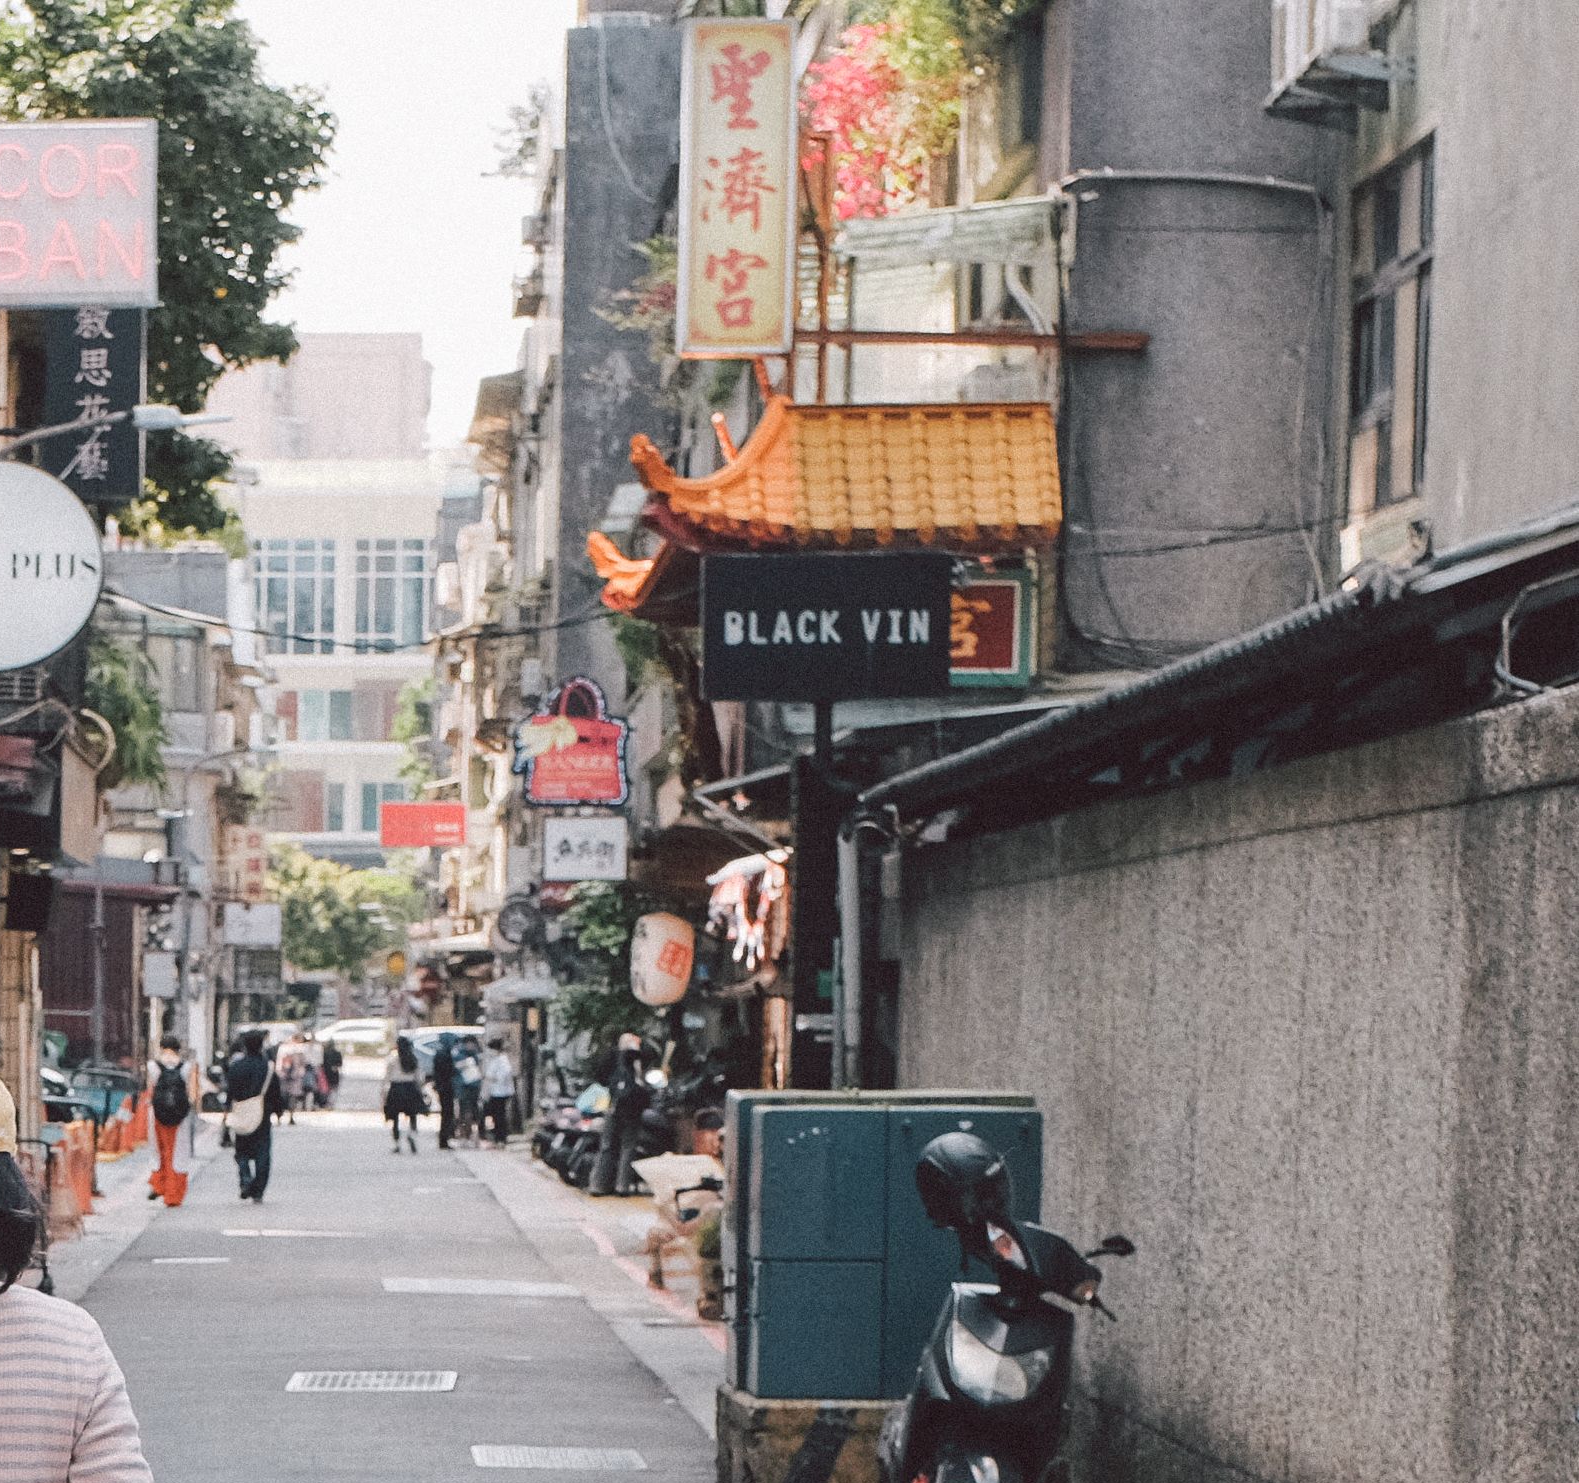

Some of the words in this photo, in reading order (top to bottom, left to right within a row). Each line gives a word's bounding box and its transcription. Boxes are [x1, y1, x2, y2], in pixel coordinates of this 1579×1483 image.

[701, 44, 778, 329] 聖濟宮
[11, 549, 99, 579] PLUS
[723, 609, 840, 646] BLACK
[861, 609, 931, 645] VIN
